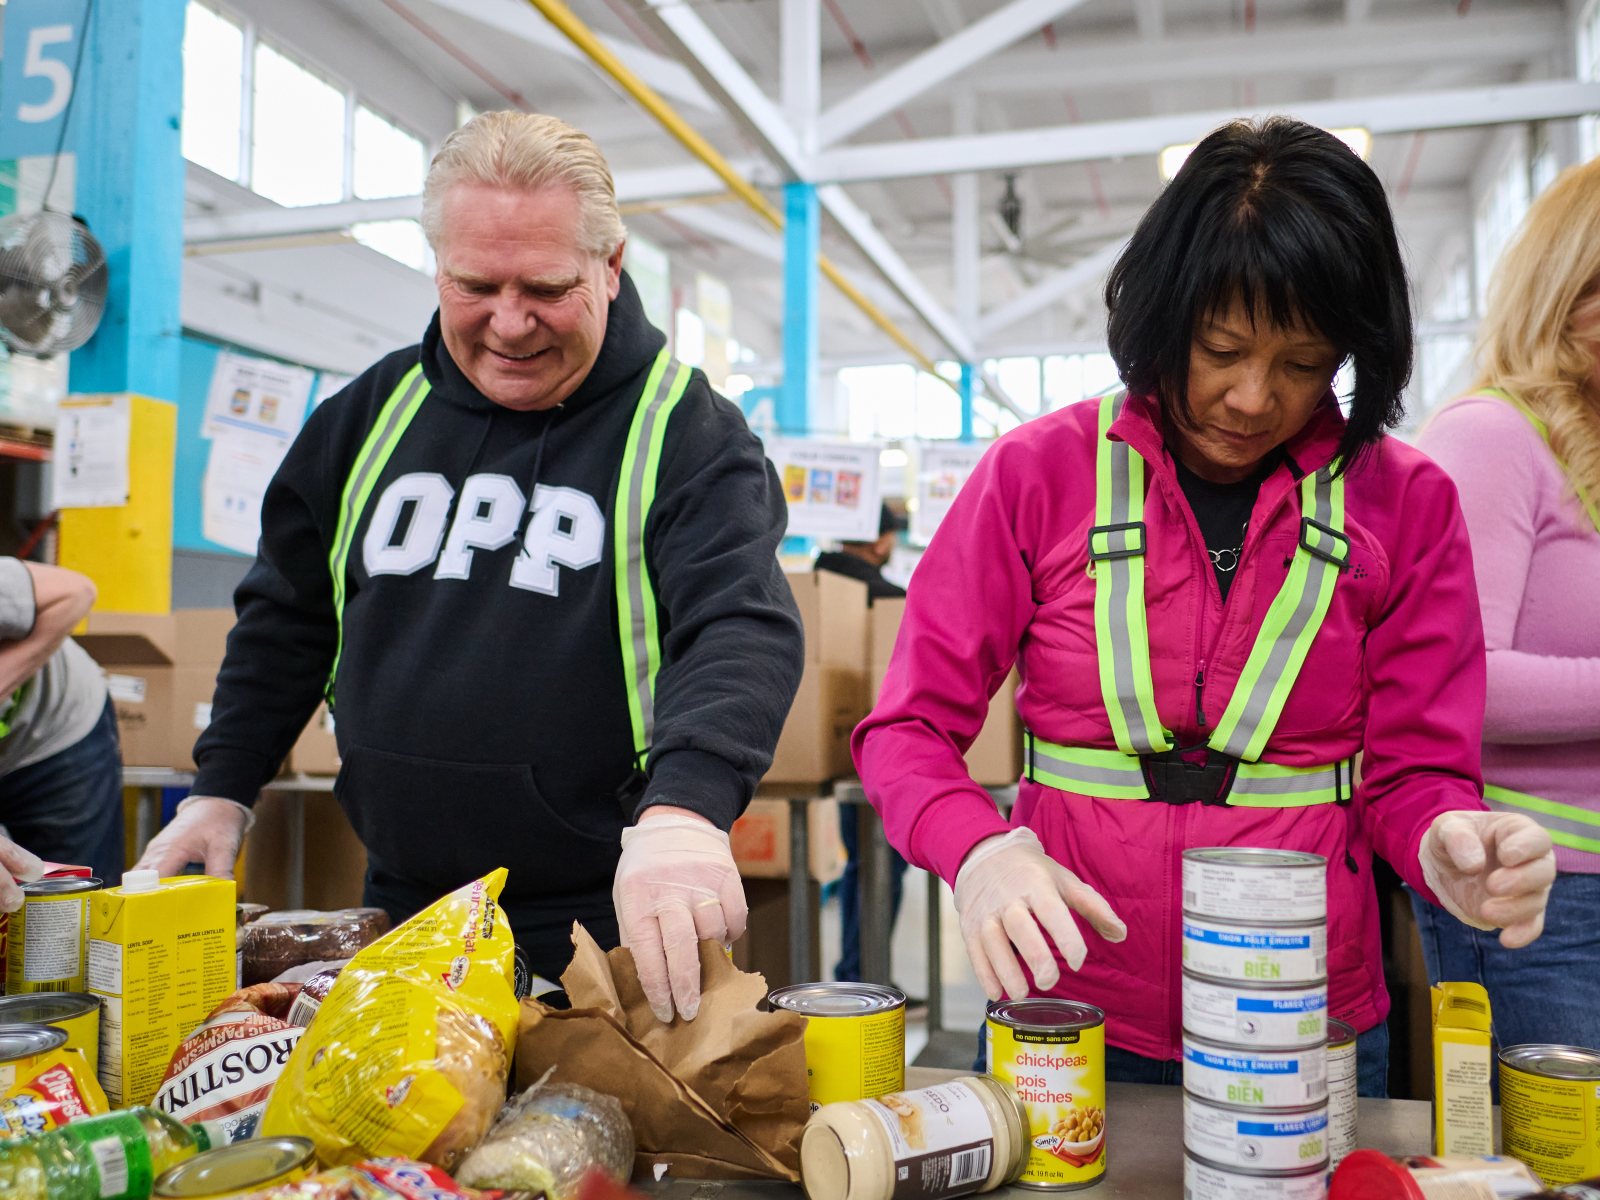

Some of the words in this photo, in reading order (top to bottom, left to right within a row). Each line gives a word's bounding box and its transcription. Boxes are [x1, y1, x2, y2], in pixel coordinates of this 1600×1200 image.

[17, 24, 74, 123] 5
[363, 472, 605, 597] OPP
[177, 932, 191, 940] SOUPE
[201, 928, 225, 937] LENTILLES
[127, 941, 141, 949] LENTIL
[1244, 960, 1281, 979] BIEN
[248, 1021, 294, 1037] ARLIC
[173, 1027, 244, 1075] PARMESAN
[1016, 1053, 1088, 1071] chickpeas
[158, 1036, 301, 1114] ROSTINI
[1016, 1074, 1047, 1088] pois
[1017, 1088, 1073, 1103] chiches
[1227, 1084, 1264, 1103] BIEN
[1035, 1136, 1058, 1147] Simple
